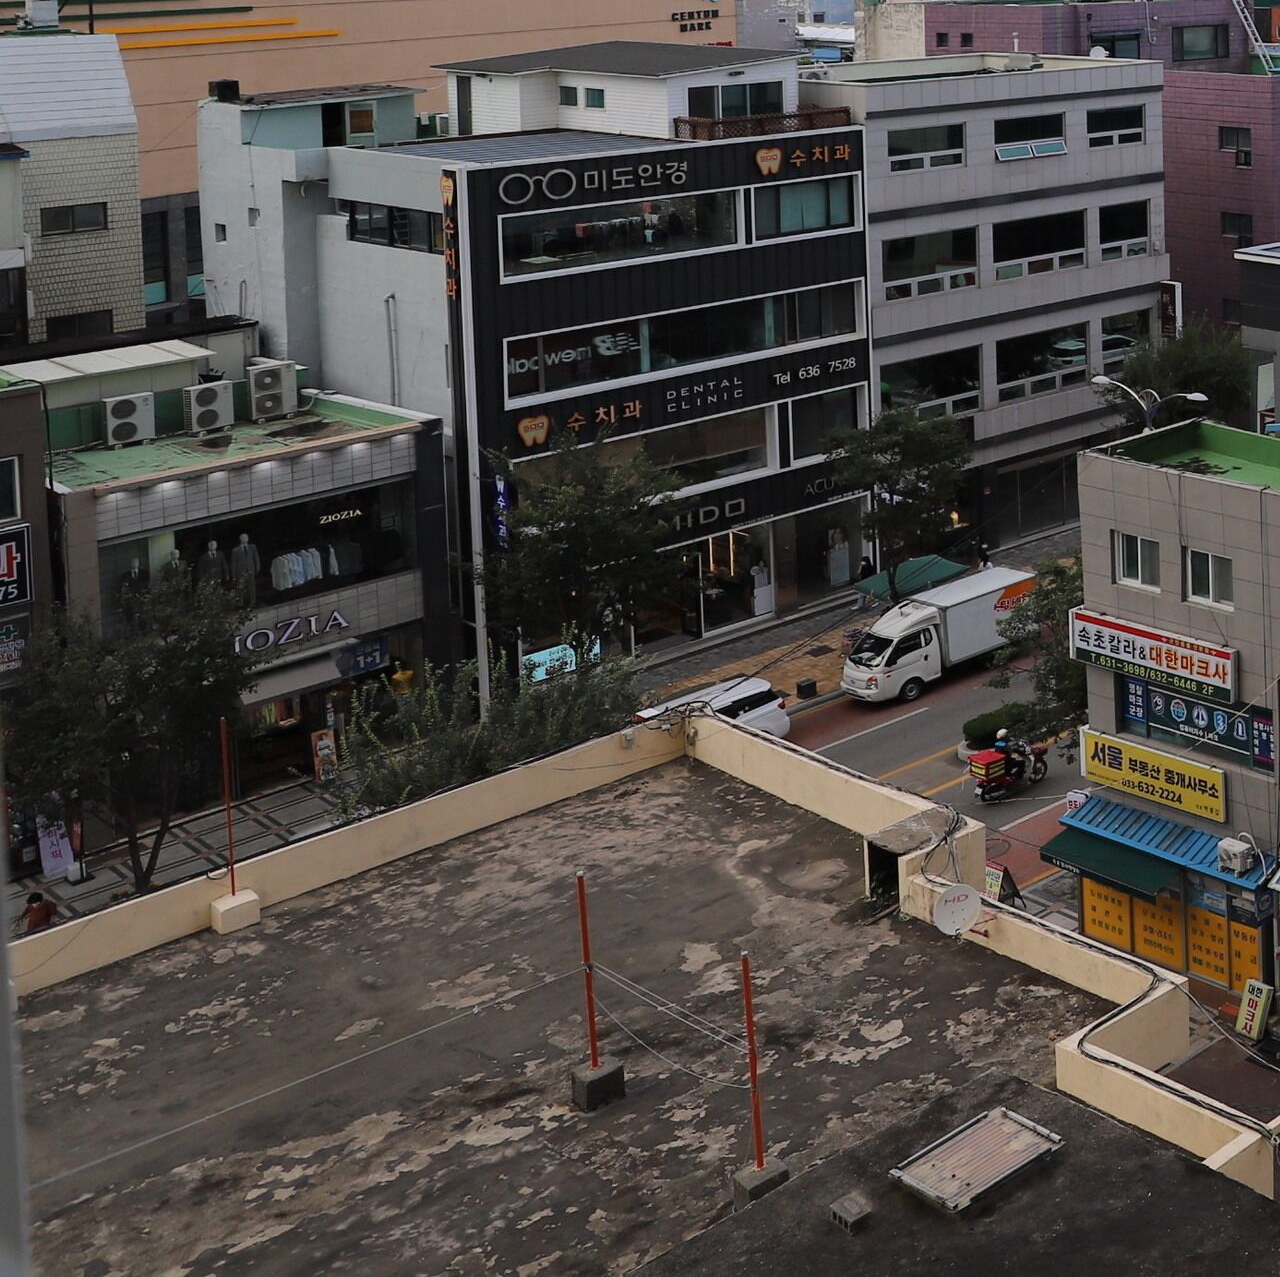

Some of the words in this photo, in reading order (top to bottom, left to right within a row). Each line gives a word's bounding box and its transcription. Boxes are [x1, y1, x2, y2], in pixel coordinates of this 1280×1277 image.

[789, 143, 852, 168] 수치과
[583, 160, 689, 191] 미도안경
[442, 216, 458, 301] 수치과
[773, 370, 791, 386] Tel
[798, 364, 821, 380] 636
[828, 356, 857, 373] 7528
[666, 377, 743, 400] DENTAL
[667, 388, 744, 412] CLINIC
[566, 399, 644, 433] 수치과
[319, 509, 363, 524] ZIOZIA
[234, 609, 349, 655] IOZIA
[1202, 684, 1214, 696] 2F
[1090, 740, 1123, 771] 서울
[1128, 756, 1161, 782] 부동산
[1164, 767, 1219, 799] 중개사무소
[1121, 777, 1183, 804] 033-632-2224
[944, 894, 969, 906] HD
